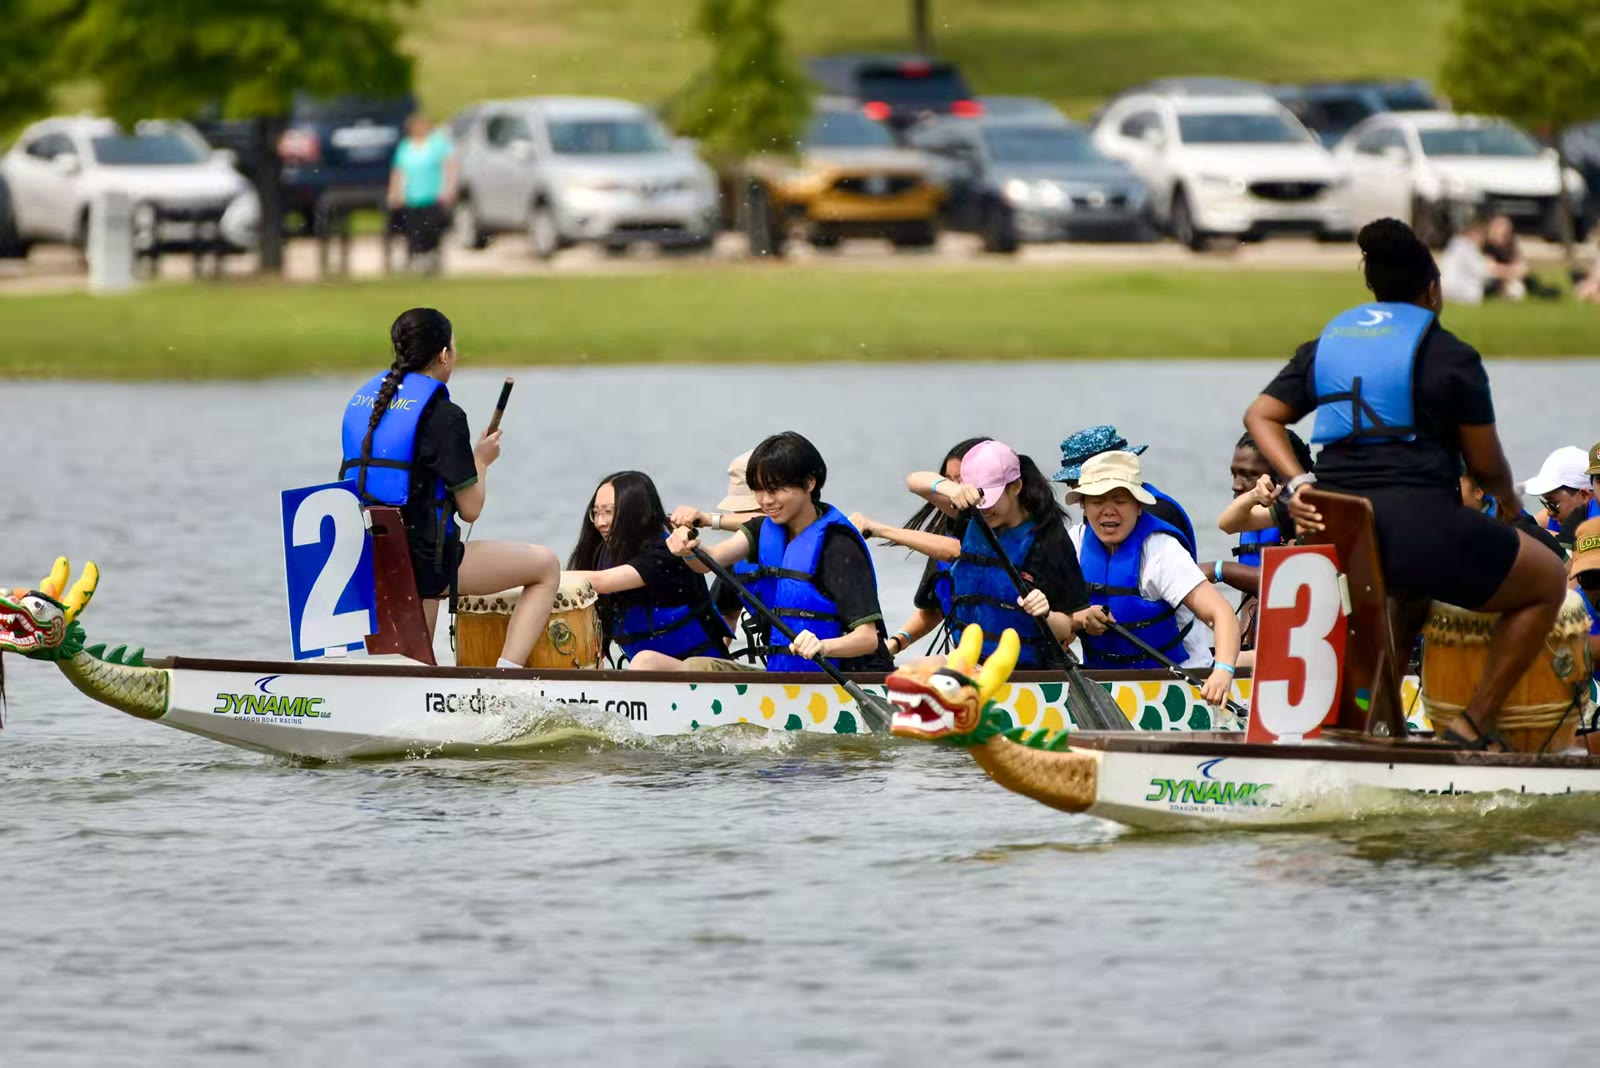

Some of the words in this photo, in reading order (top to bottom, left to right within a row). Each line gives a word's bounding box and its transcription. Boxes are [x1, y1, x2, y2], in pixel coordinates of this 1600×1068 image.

[352, 395, 417, 411] DYNMIC
[1582, 537, 1600, 548] LOT
[292, 487, 371, 653] 2
[1257, 552, 1342, 735] 3
[214, 693, 322, 718] DYNAMIC
[234, 715, 260, 723] DRAGON
[1169, 804, 1198, 812] DRAGON
